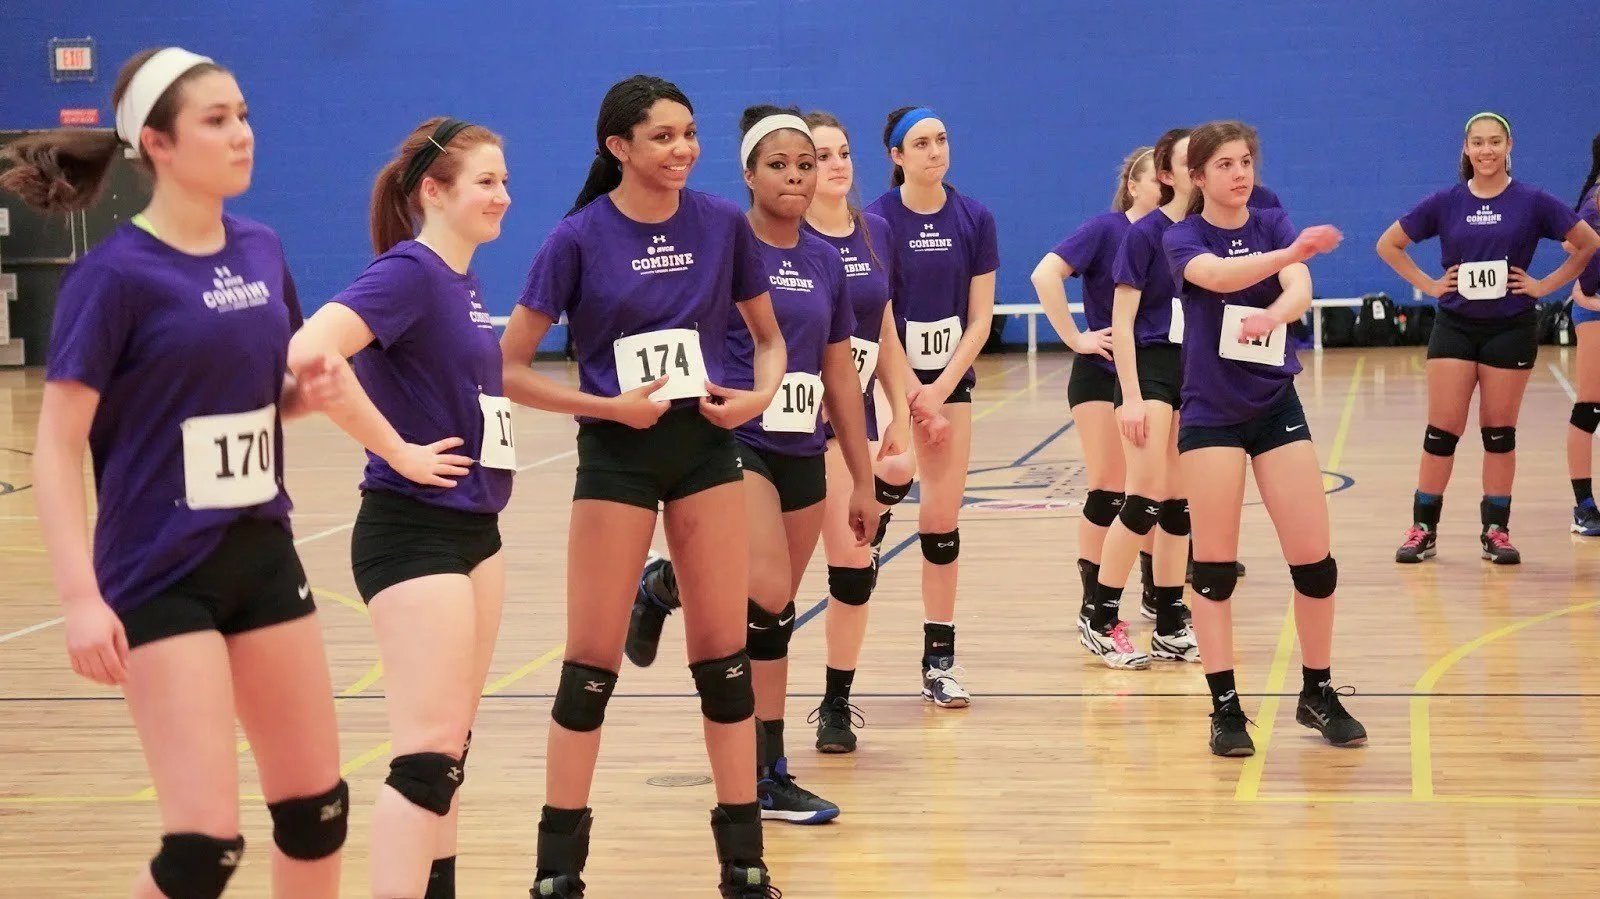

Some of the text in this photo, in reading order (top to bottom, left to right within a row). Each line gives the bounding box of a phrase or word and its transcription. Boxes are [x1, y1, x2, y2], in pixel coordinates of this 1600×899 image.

[909, 238, 953, 249] COMBINE
[631, 253, 694, 271] COMBINE
[844, 262, 872, 273] BINE
[769, 275, 815, 289] COMBINE
[1468, 269, 1496, 289] 140
[921, 327, 951, 355] 107
[636, 342, 690, 383] 174
[782, 383, 814, 414] 104
[214, 428, 270, 479] 170
